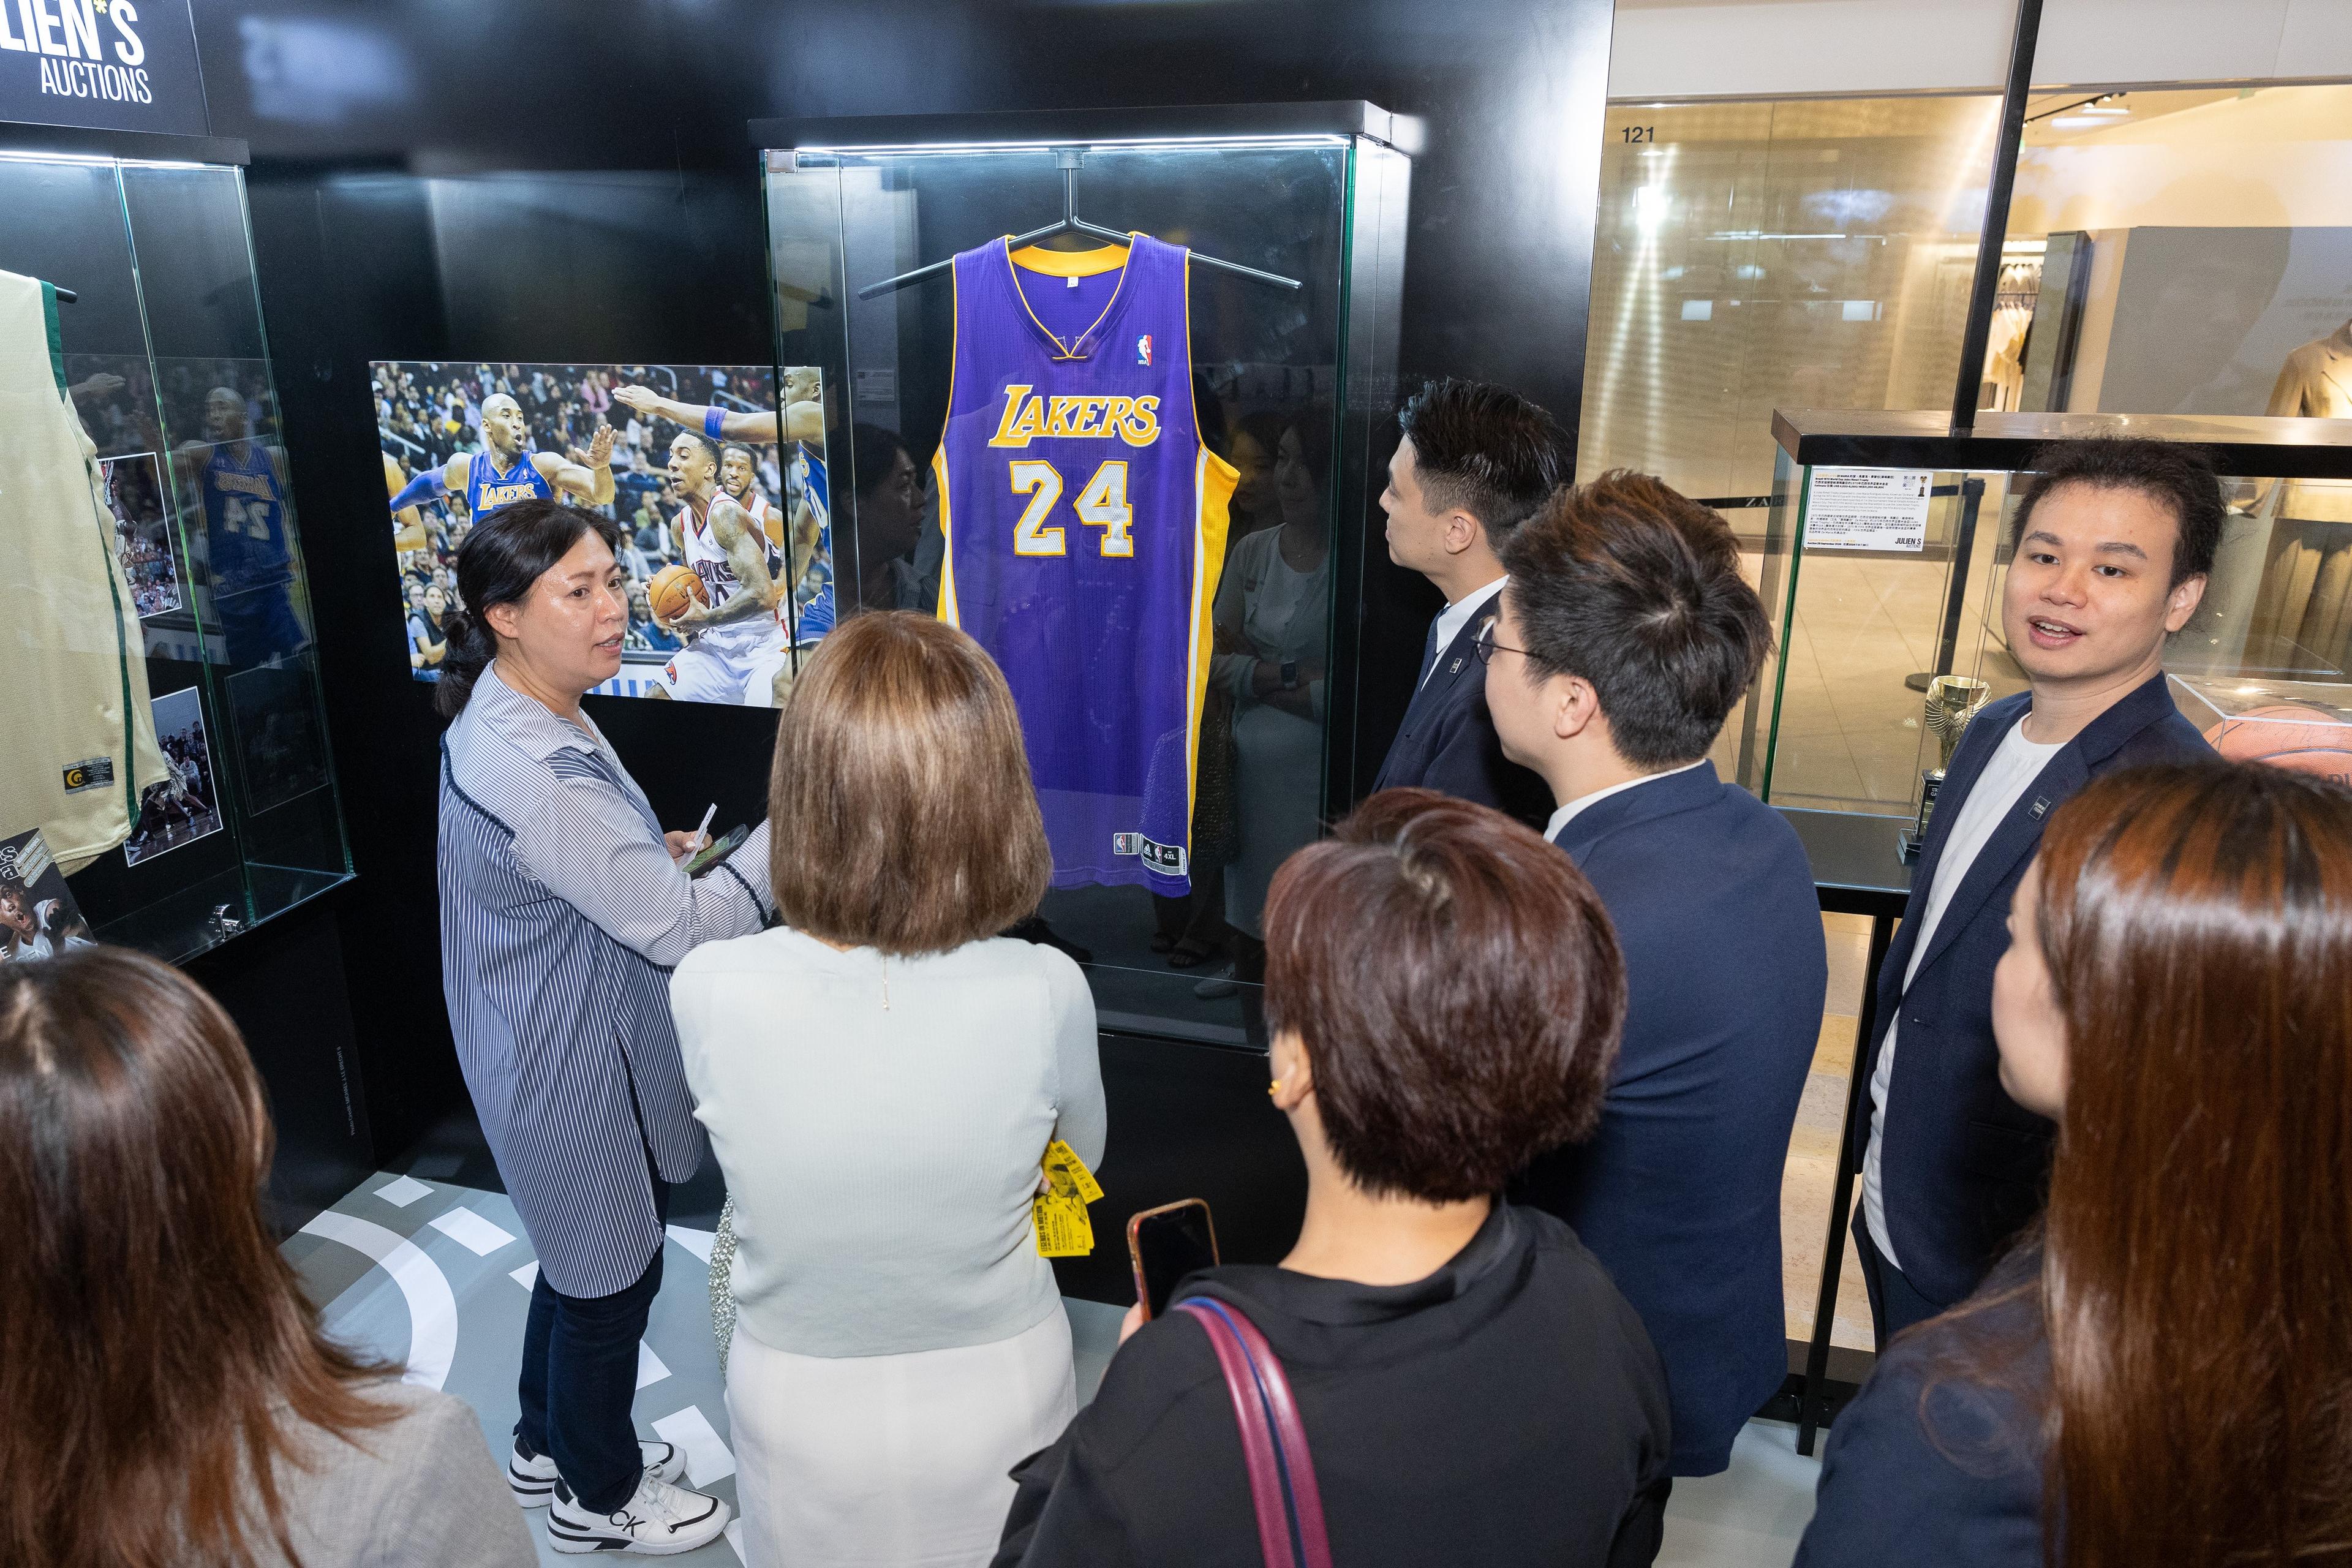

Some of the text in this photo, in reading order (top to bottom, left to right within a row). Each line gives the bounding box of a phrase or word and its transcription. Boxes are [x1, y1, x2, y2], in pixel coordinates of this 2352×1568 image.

[40, 57, 153, 104] AUCTIONS
[1622, 126, 1655, 144] 121
[987, 384, 1161, 448] LAKERS
[478, 482, 537, 511] LAKERS
[1009, 458, 1134, 558] 24
[16, 837, 40, 864] Winter Olympics
[609, 1509, 647, 1537] CK
